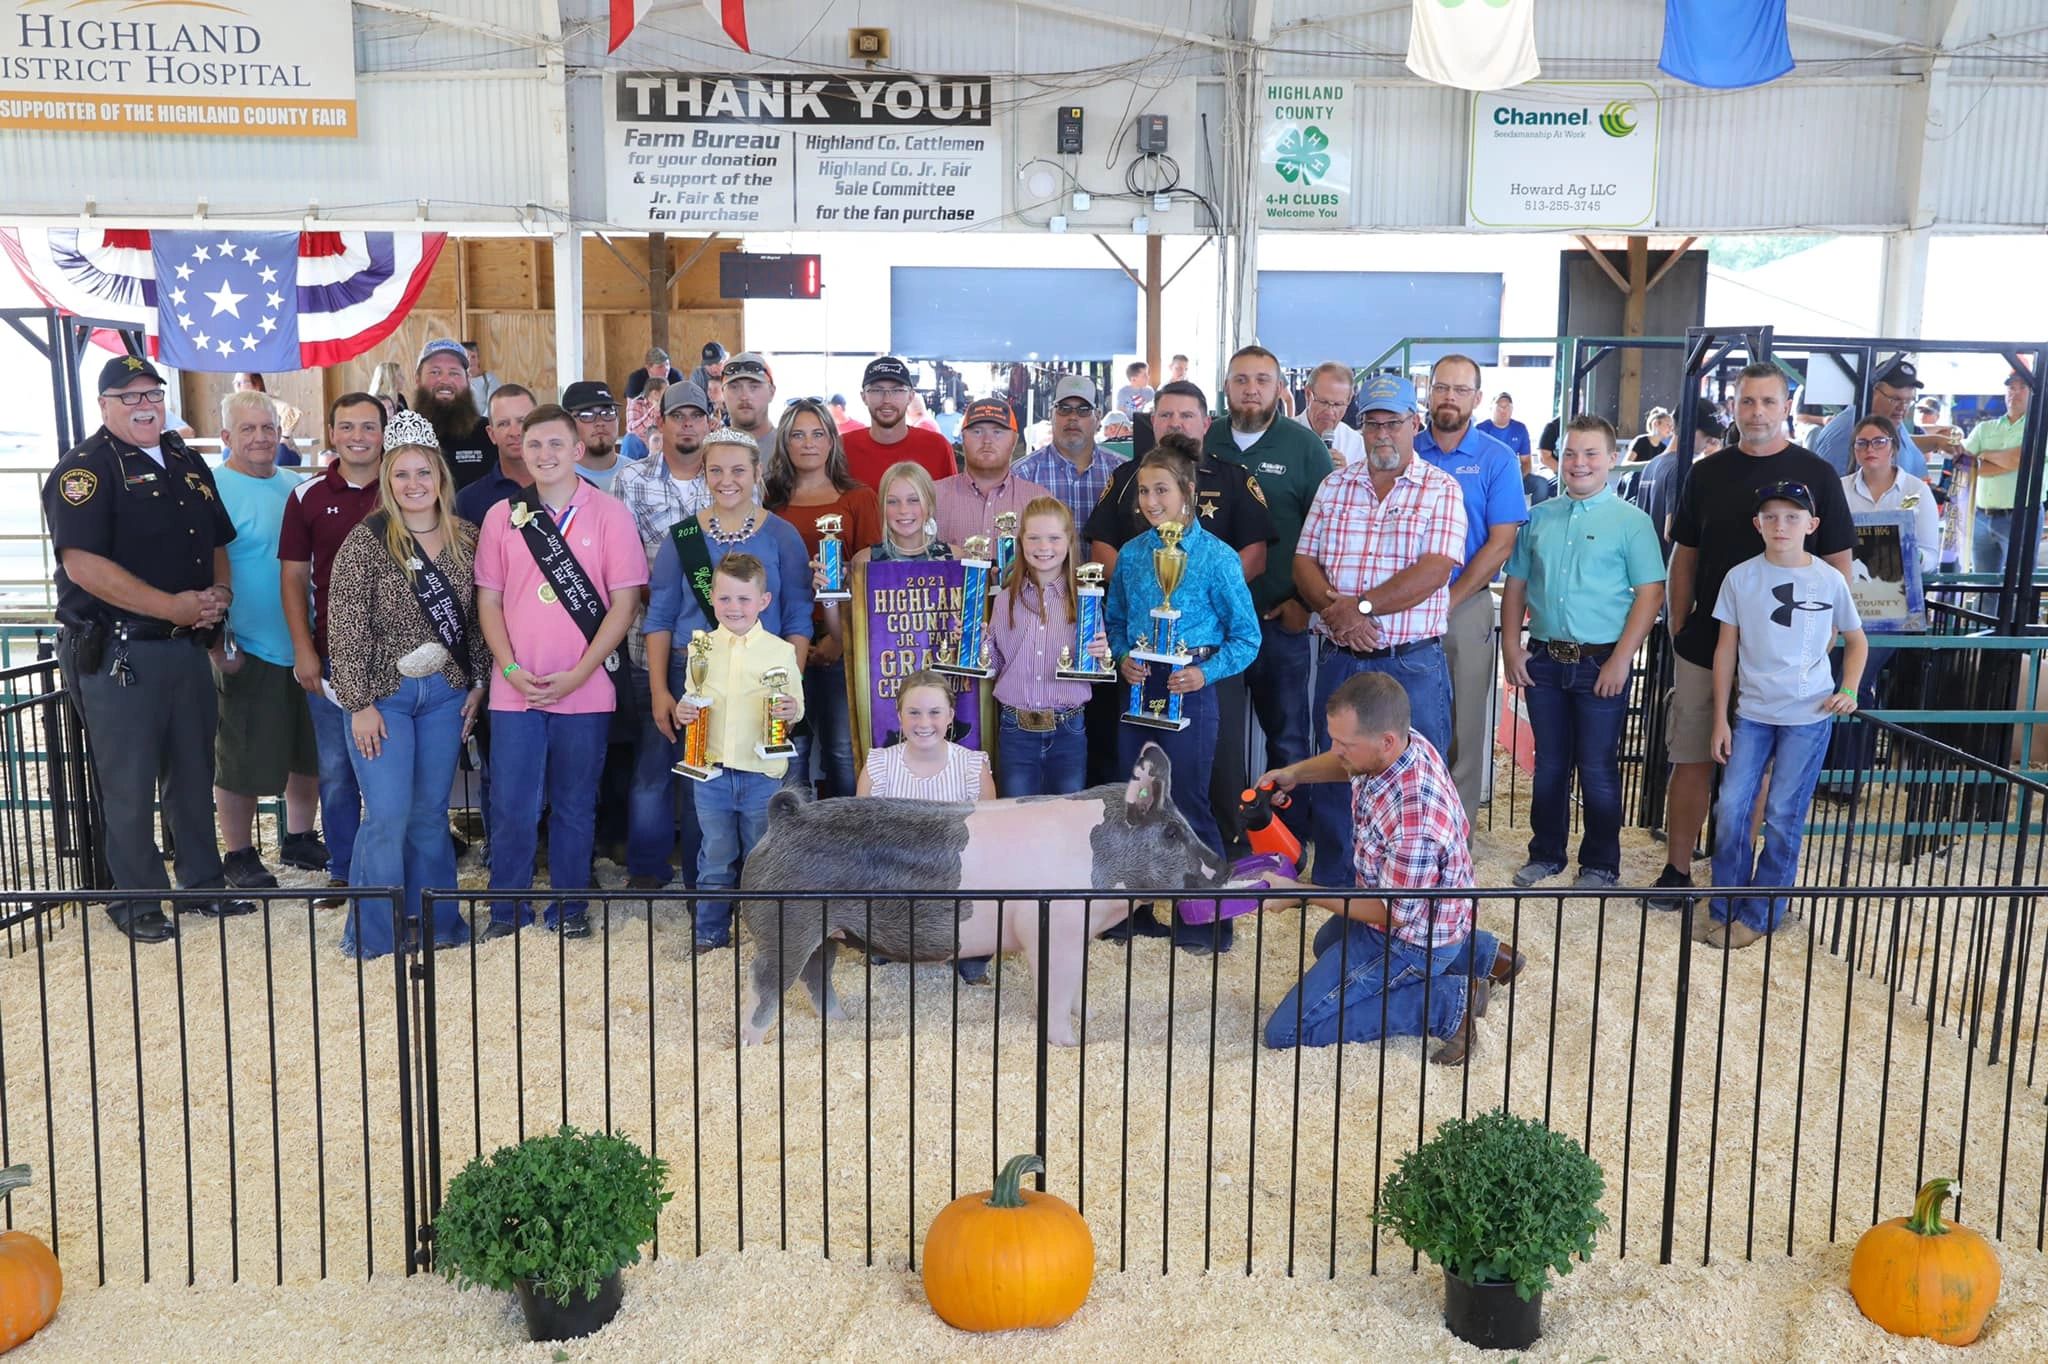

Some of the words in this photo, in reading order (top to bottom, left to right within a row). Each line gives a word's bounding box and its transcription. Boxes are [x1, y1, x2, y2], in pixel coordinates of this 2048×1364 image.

[16, 13, 261, 54] HIGHLAND
[145, 56, 311, 87] HOSPITAL
[626, 78, 830, 118] THANK
[847, 81, 982, 120] YOU!
[1268, 85, 1343, 100] HIGHLAND
[0, 100, 96, 121] SUPPORTER
[100, 103, 120, 121] OF
[124, 104, 154, 122] THE
[158, 105, 240, 125] HIGHLAND
[243, 107, 308, 126] COUNTY
[312, 107, 347, 127] FAIR
[1275, 106, 1334, 120] COUNTY
[1493, 107, 1588, 125] Channel
[624, 128, 685, 147] Farm
[691, 130, 780, 149] Bureau
[1565, 130, 1586, 138] Work
[805, 135, 874, 154] Highland
[877, 136, 900, 151] Co.
[904, 136, 985, 151] Cattlemen
[628, 152, 654, 166] for
[657, 155, 697, 168] your
[701, 153, 777, 167] donation
[818, 161, 886, 179] Highland
[890, 162, 913, 176] Co.
[916, 162, 937, 177] Jr.
[941, 162, 972, 177] Fair
[633, 171, 645, 184] &
[649, 173, 717, 188] support
[721, 173, 741, 186] of
[744, 173, 773, 187] the
[834, 181, 868, 195] Sale
[872, 181, 956, 196] Committee
[1510, 184, 1563, 195] Howard
[1567, 184, 1586, 198] Ag
[1590, 184, 1616, 195] LLC
[649, 190, 671, 204] Jr.
[676, 191, 709, 204] Fair
[713, 192, 725, 205] &
[730, 192, 759, 205] the
[1266, 194, 1288, 205] 4-H
[1293, 194, 1339, 205] CLUBS
[1524, 201, 1601, 211] 513-255-3745
[648, 207, 676, 220] fan
[679, 208, 759, 223] purchase
[816, 205, 840, 220] for
[843, 205, 870, 220] the
[873, 205, 899, 220] fan
[902, 206, 975, 223] purchase
[1267, 208, 1315, 218] Welcome
[1318, 208, 1338, 218] You
[678, 526, 698, 538] 2021
[546, 534, 564, 557] 2021
[560, 558, 593, 600] Highland
[424, 572, 445, 595] 2021
[541, 553, 554, 565] Jr.
[552, 567, 567, 585] Fair
[564, 586, 582, 611] King
[906, 576, 945, 587] 2021
[418, 589, 432, 602] Jr.
[429, 603, 443, 621] Fair
[874, 587, 962, 613] HIGHLAN
[896, 634, 920, 647] JR.
